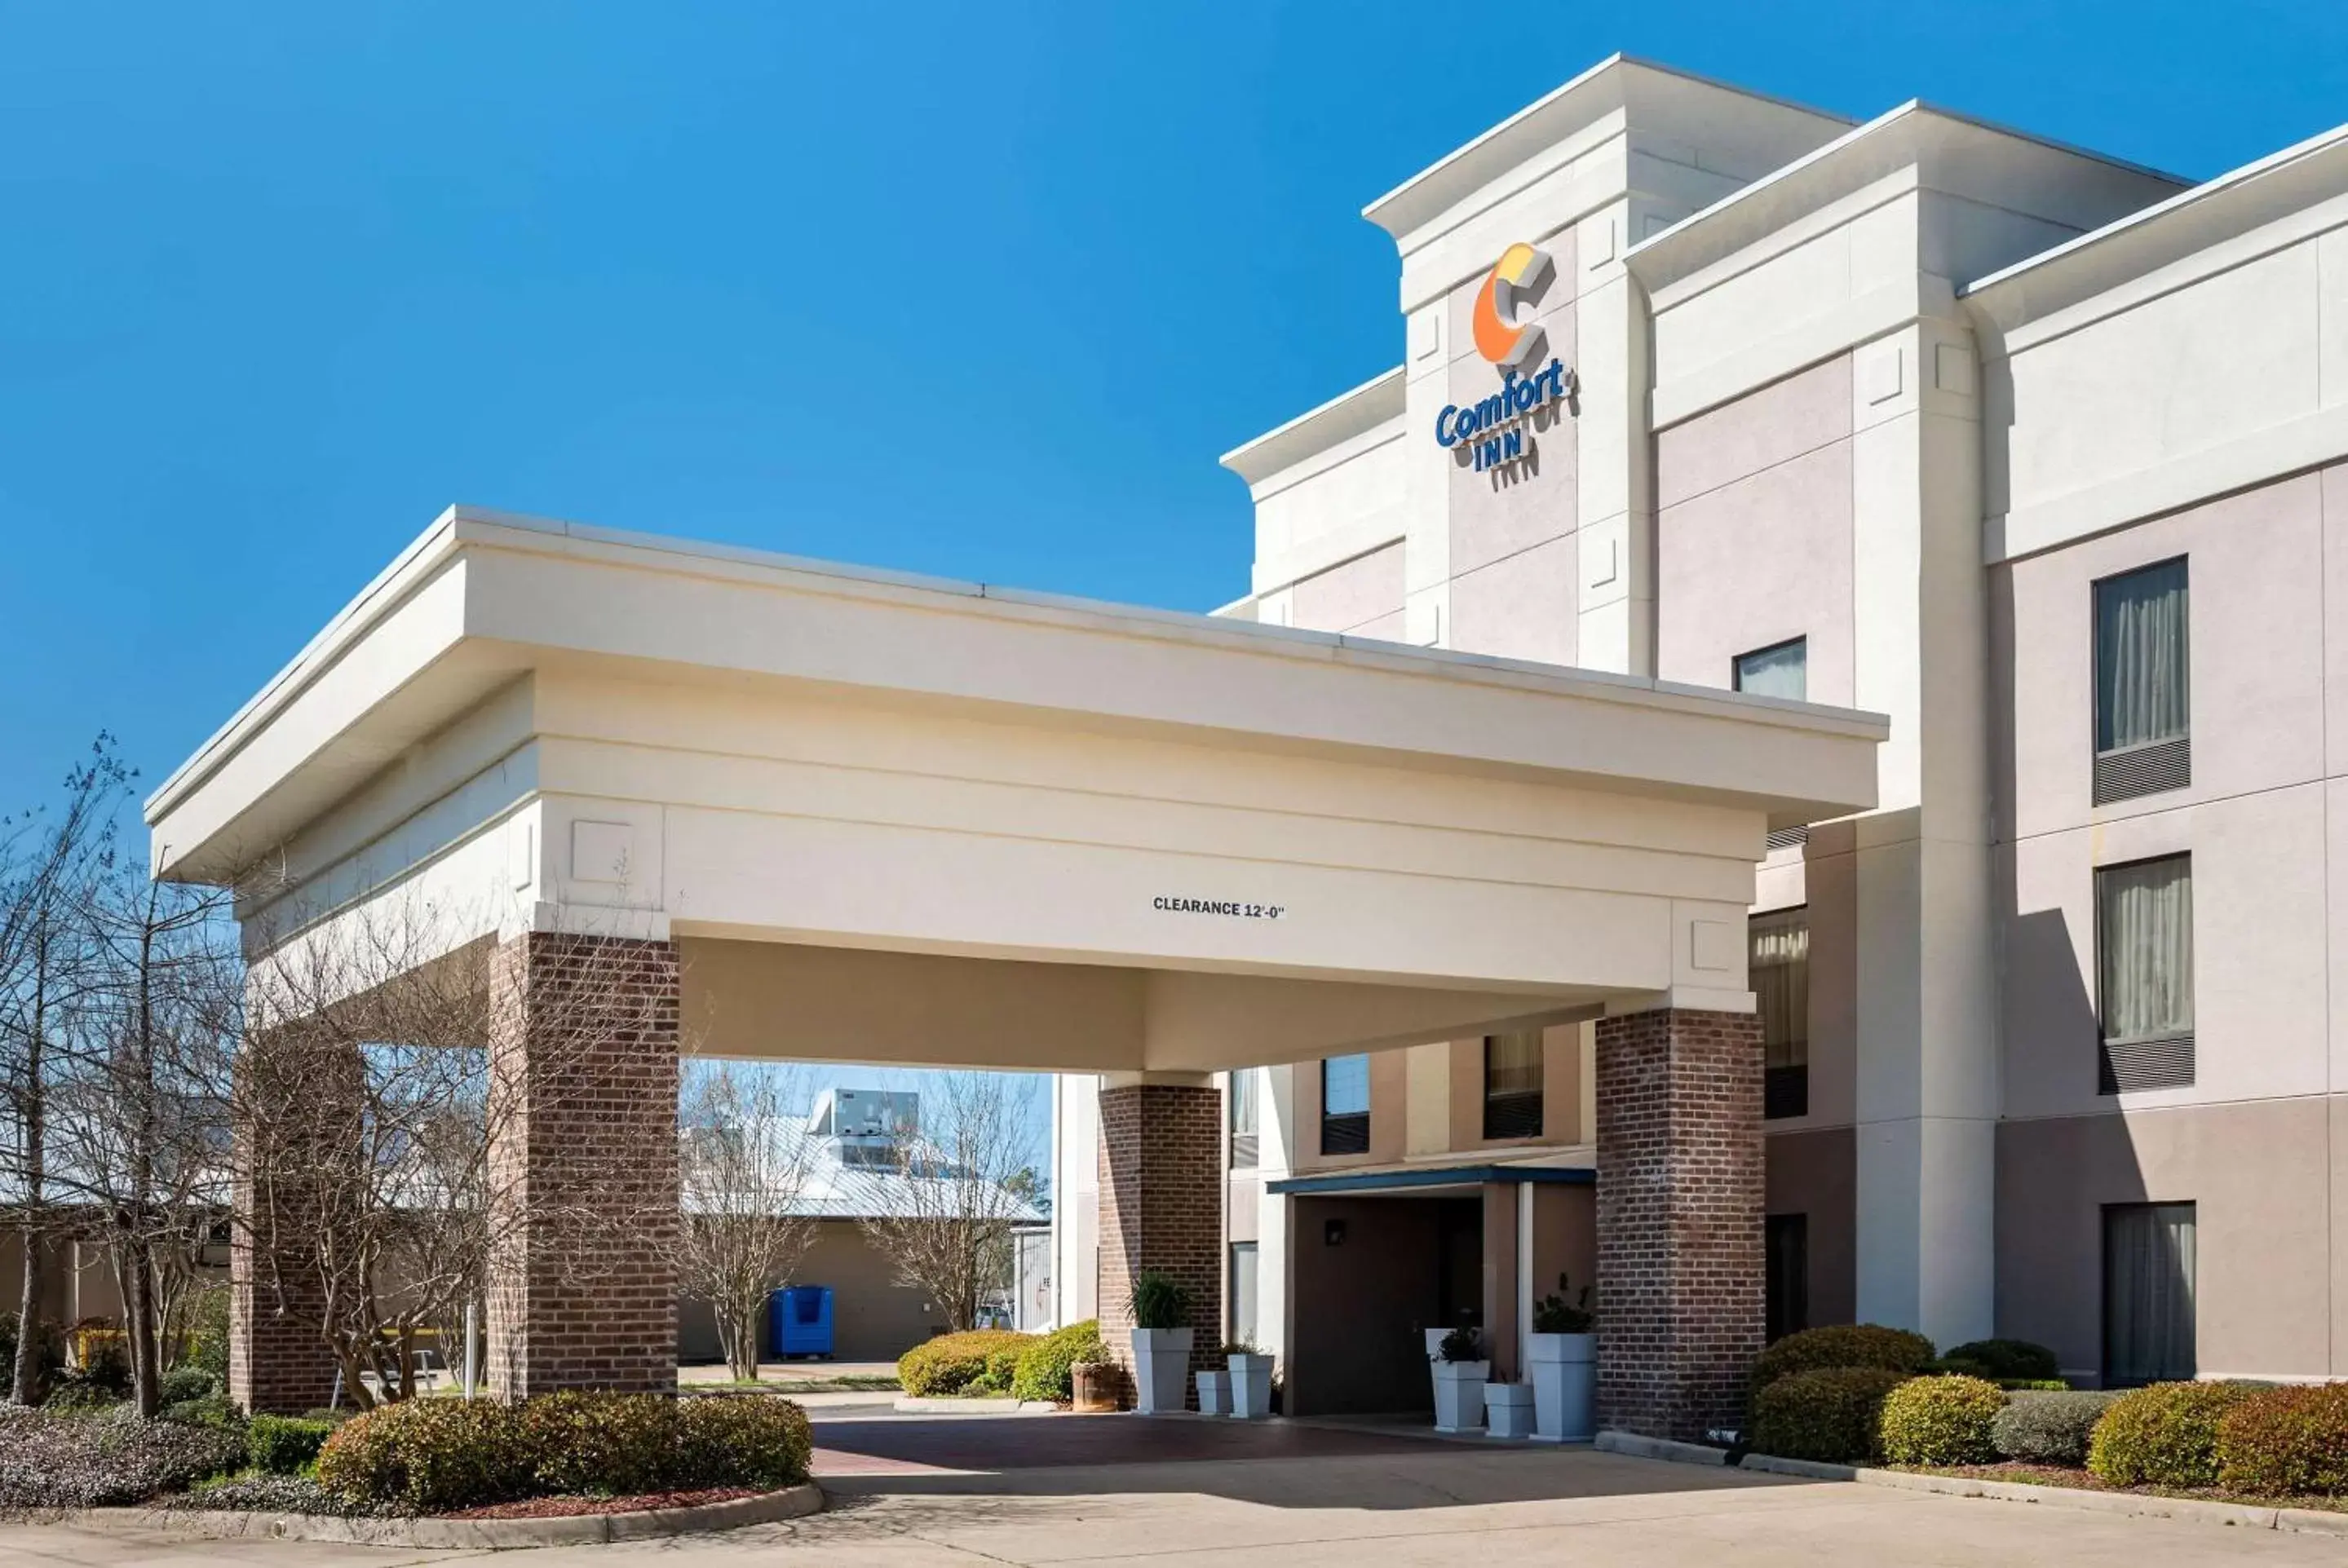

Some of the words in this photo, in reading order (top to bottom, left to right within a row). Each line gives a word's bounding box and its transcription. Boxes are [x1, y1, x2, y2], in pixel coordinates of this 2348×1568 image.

[1435, 357, 1563, 448] Comfort
[1474, 427, 1522, 473] INN
[1153, 897, 1240, 916] CLEARANCE
